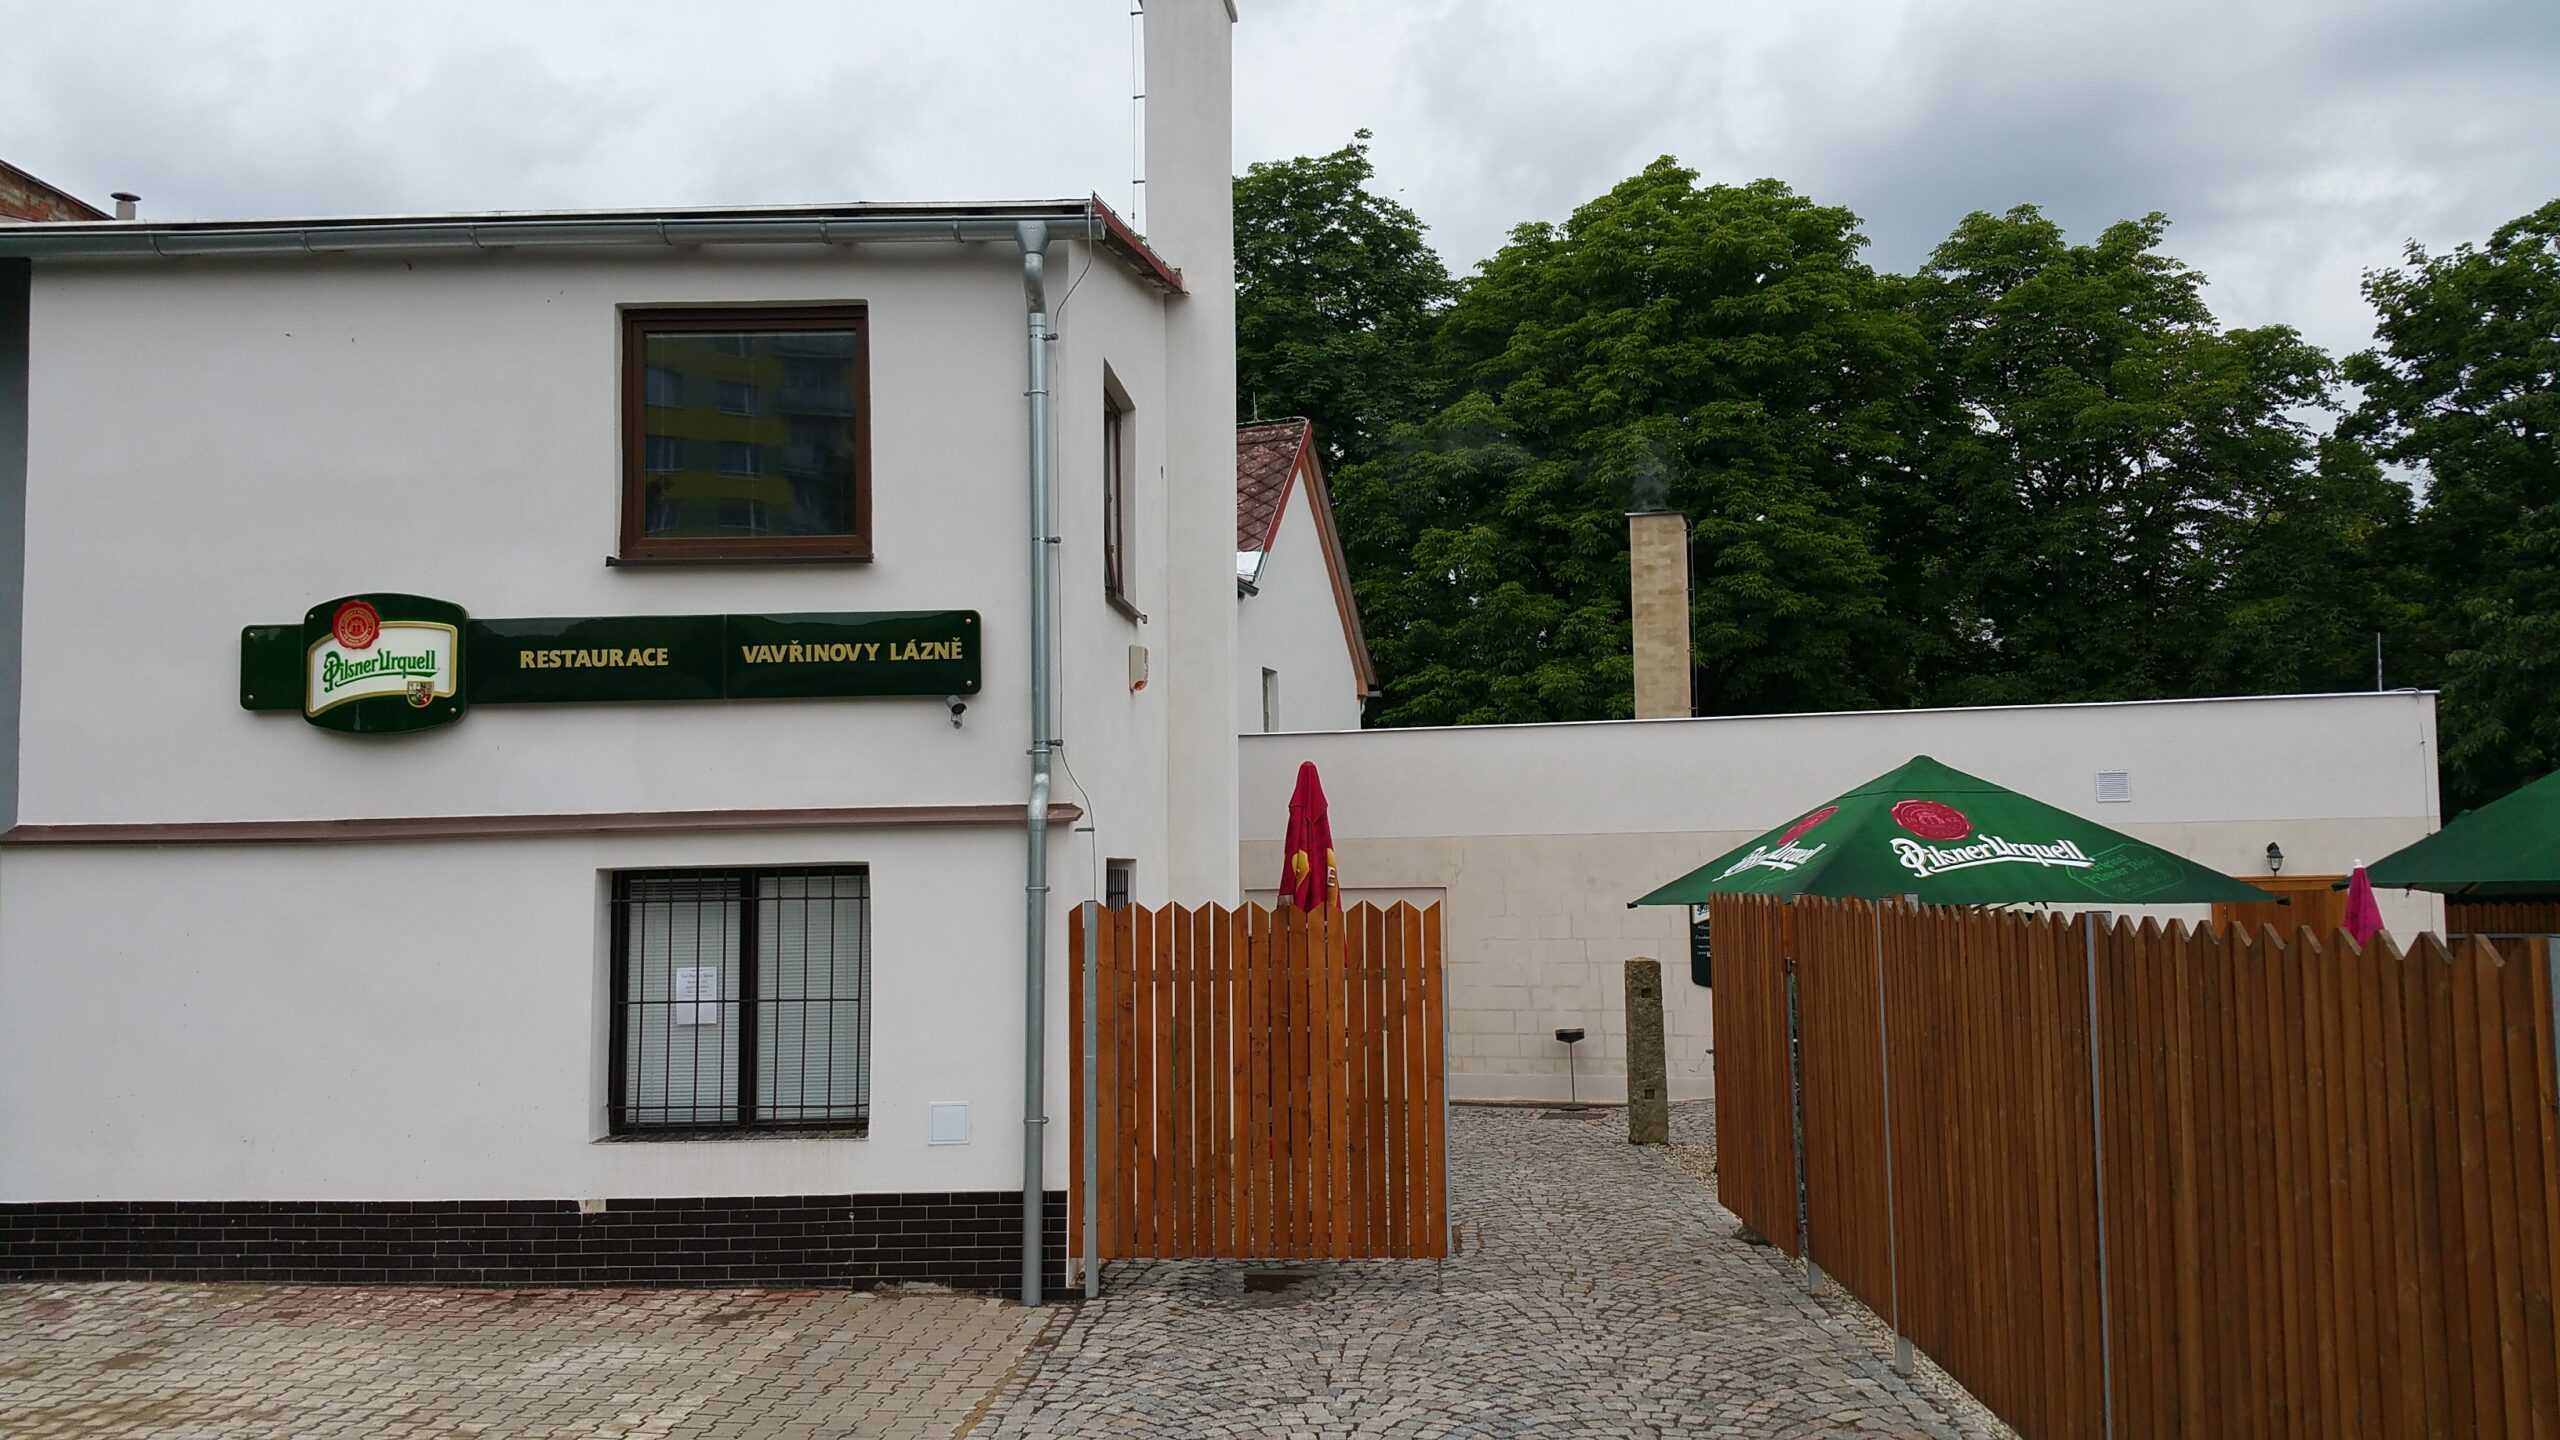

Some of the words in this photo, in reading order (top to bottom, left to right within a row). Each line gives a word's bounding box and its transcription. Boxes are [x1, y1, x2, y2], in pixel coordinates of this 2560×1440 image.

[520, 647, 669, 669] RESTAURACE
[741, 640, 880, 664] VAVŘINOVY
[890, 637, 963, 661] LÁZNĚ
[322, 650, 379, 694] Pilsner
[377, 648, 437, 679] Urquell
[1889, 837, 1990, 879] Pilsner
[1977, 834, 2092, 868] Urquell
